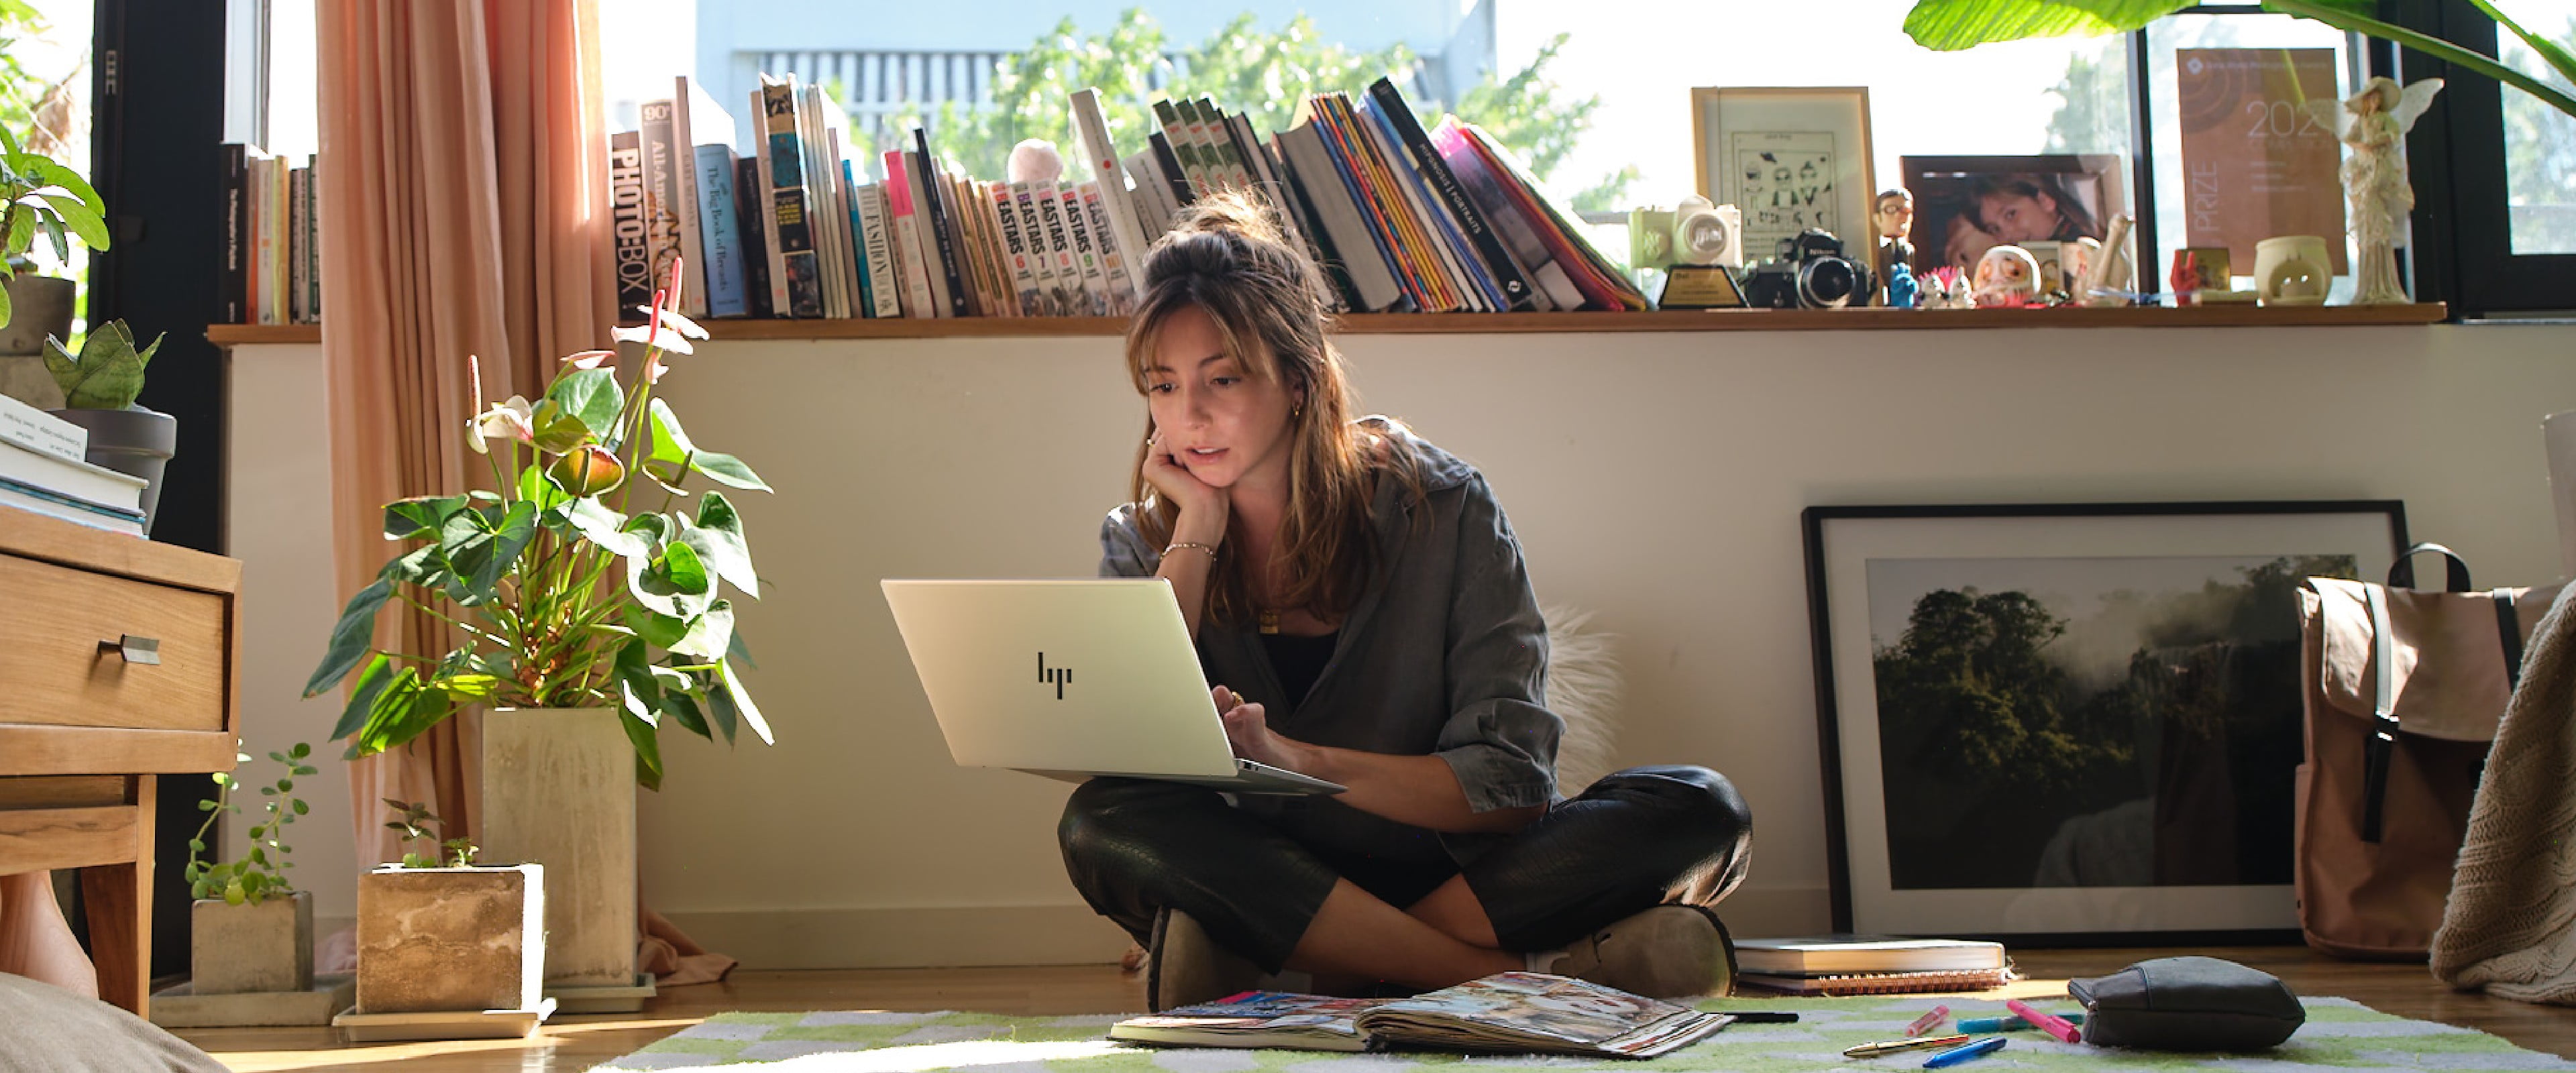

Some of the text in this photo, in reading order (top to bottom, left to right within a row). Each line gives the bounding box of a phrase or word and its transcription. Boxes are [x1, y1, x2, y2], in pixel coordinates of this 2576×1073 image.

[2247, 100, 2320, 138] 202
[707, 166, 718, 187] The
[2192, 160, 2221, 231] PRIZE
[712, 209, 724, 237] Book
[996, 192, 1024, 254] BEASTARS
[1015, 255, 1026, 269] 6
[1017, 193, 1046, 254] BEASTARS
[1038, 256, 1045, 268] 7
[1038, 190, 1068, 252] BEASTARS
[1062, 190, 1092, 253] BEASTARS
[1084, 193, 1117, 254] BEASTARS
[1451, 190, 1481, 234] PORTRAITS
[865, 214, 887, 274] FASHION
[1038, 652, 1072, 700] hp
